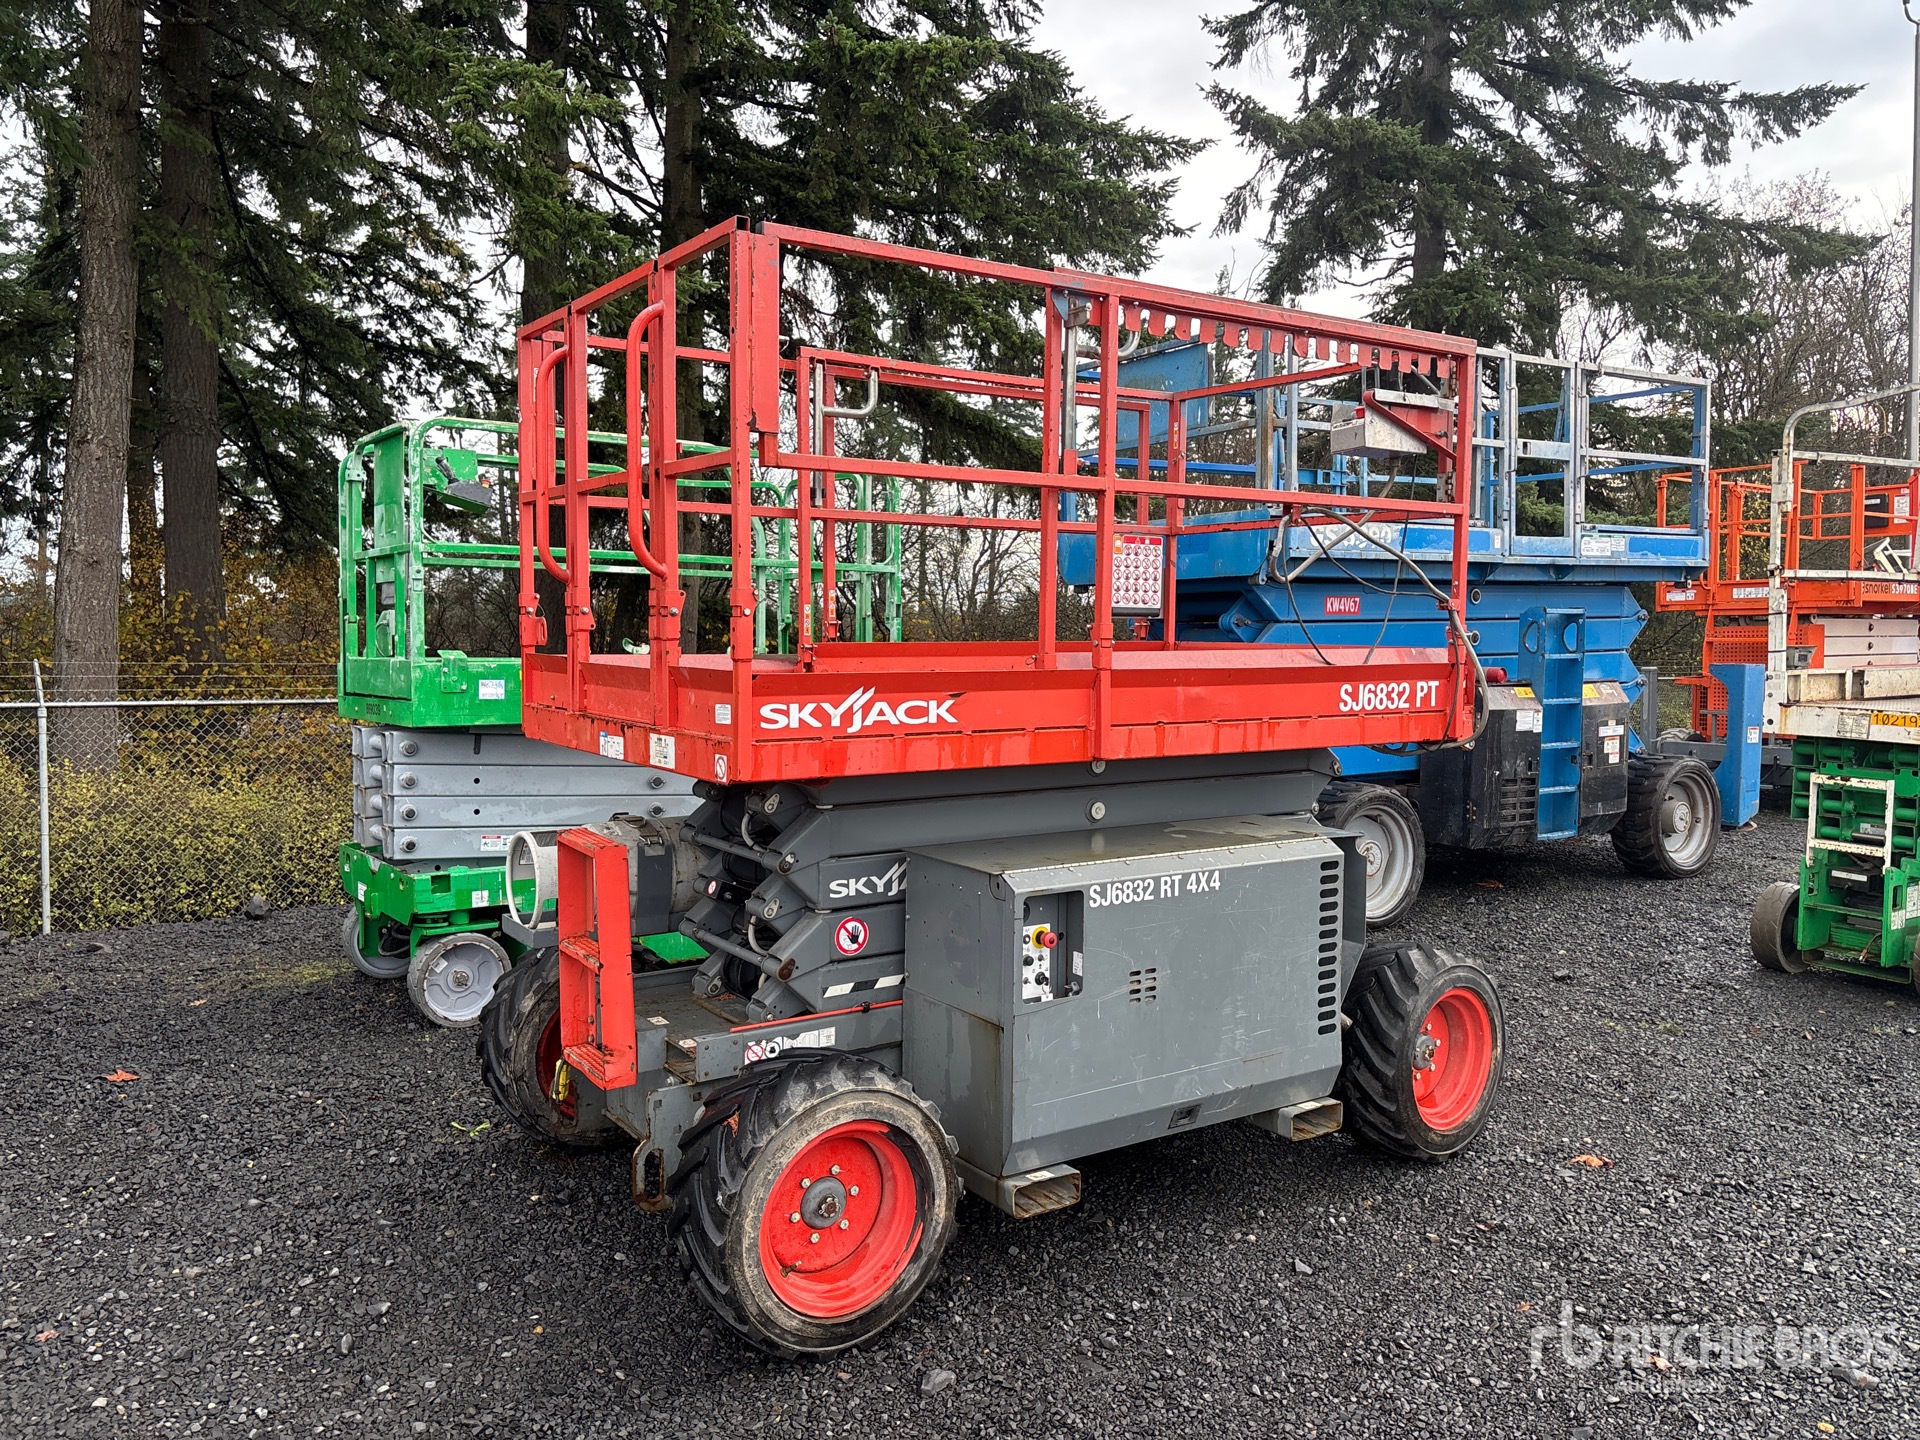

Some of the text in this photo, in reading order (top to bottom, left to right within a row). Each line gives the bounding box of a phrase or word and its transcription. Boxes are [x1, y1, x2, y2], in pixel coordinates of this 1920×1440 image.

[1865, 582, 1891, 594] snorkel
[1326, 597, 1360, 612] KW4V67
[1339, 682, 1410, 712] SJ6832
[759, 686, 958, 734] SKYJACK
[1873, 713, 1920, 729] 10219
[1088, 870, 1221, 908] SJ6832 RT 4X4
